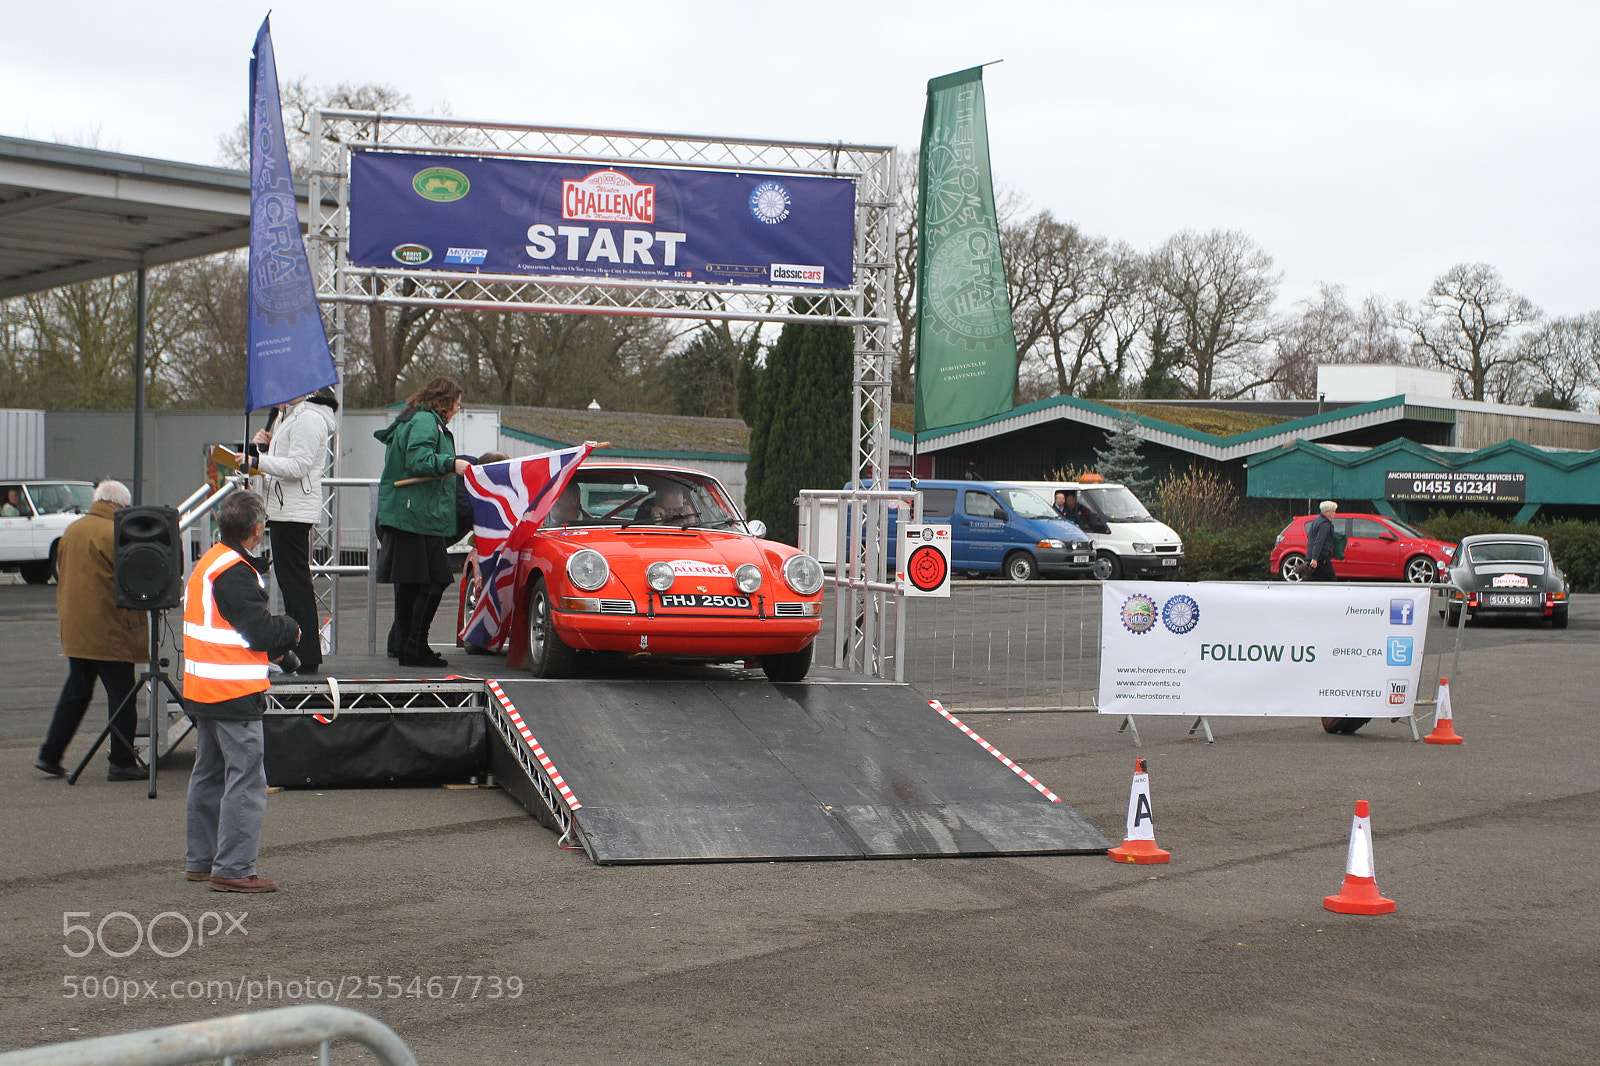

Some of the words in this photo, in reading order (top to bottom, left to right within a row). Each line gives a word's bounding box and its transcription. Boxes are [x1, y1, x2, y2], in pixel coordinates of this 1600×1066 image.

[752, 183, 773, 205] CLASSIC
[566, 184, 652, 222] CHALLENGE
[753, 207, 791, 225] ASSOCIATION
[525, 223, 687, 267] START
[448, 248, 485, 257] MOTORS
[460, 256, 472, 264] TV
[967, 230, 996, 309] CRA
[1388, 472, 1412, 480] ANCHOR
[1412, 472, 1448, 480] EXHIBITIONS
[1453, 473, 1485, 481] ELECTRICAL
[1485, 473, 1512, 481] SERVICES
[1512, 473, 1525, 482] LTD
[1413, 480, 1451, 494] 01455
[1454, 481, 1497, 495] 612341
[674, 565, 728, 575] ALLENGE
[661, 594, 697, 606] FHJ
[701, 595, 750, 608] 250D
[1164, 597, 1182, 615] CLASSIC
[1184, 597, 1198, 615] RALLY
[1345, 606, 1385, 617] /herorally
[1164, 618, 1197, 633] ASSOCIATION
[1200, 643, 1285, 662] FOLLOW
[1290, 645, 1316, 663] US
[1332, 647, 1383, 658] @HERO_CRA
[1116, 666, 1187, 675] www.heroevents.eu
[1318, 689, 1382, 698] HEROEVENTSEU
[1391, 682, 1406, 693] You
[1115, 692, 1181, 700] www.herostore.eu
[1390, 694, 1405, 704] Tube
[1134, 793, 1153, 828] A
